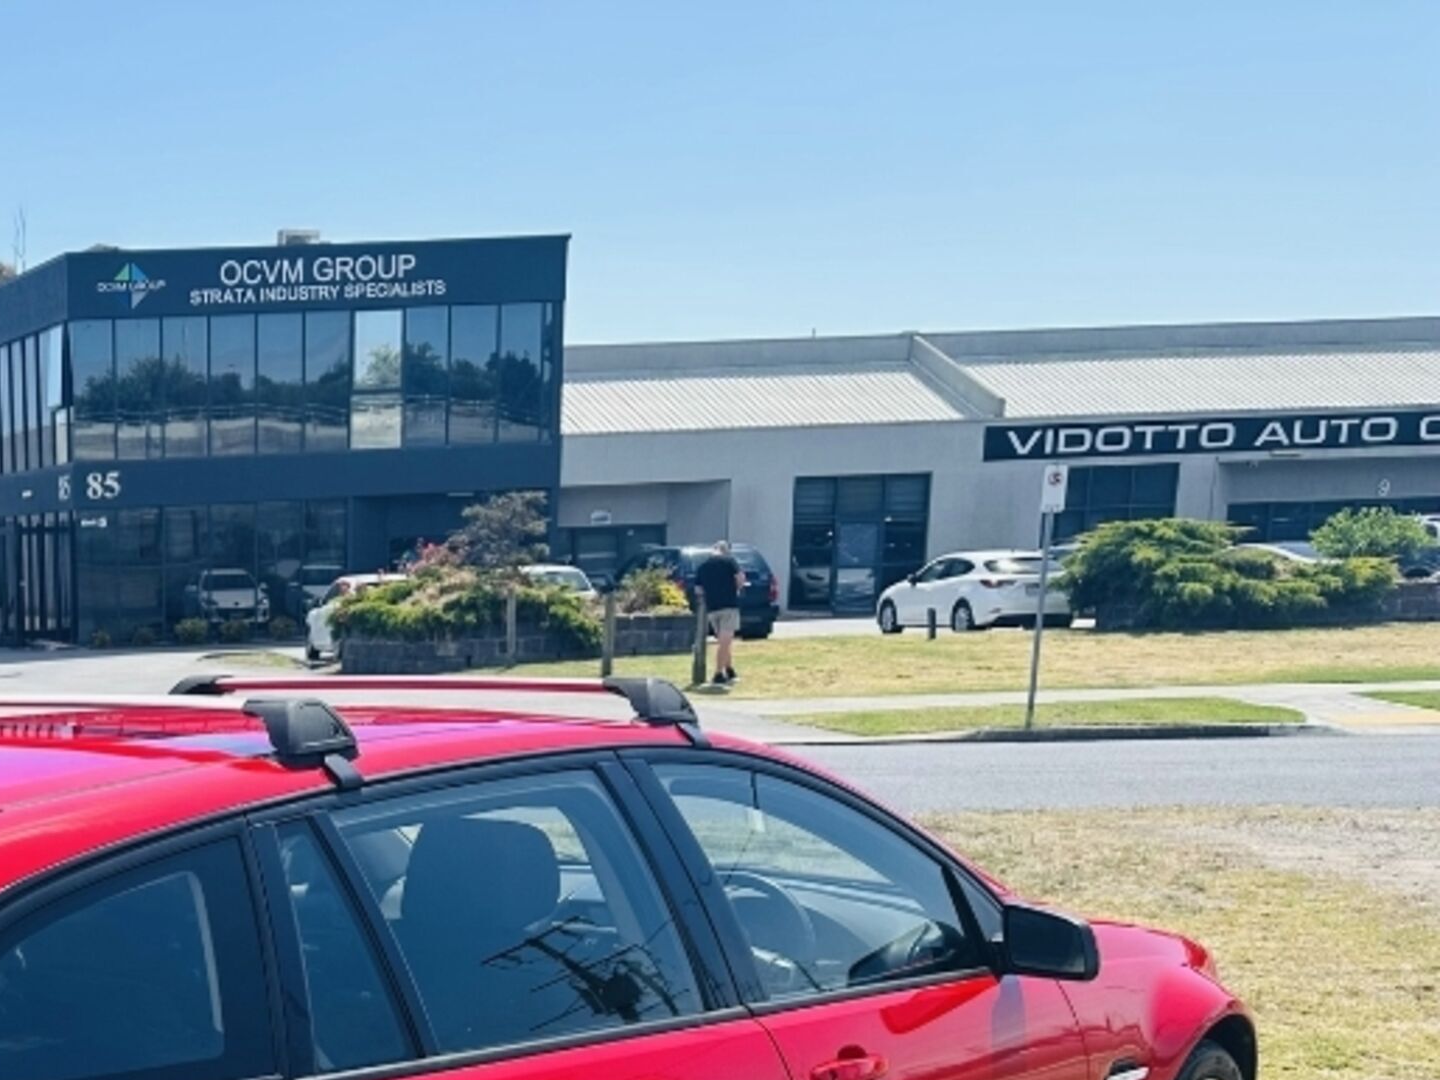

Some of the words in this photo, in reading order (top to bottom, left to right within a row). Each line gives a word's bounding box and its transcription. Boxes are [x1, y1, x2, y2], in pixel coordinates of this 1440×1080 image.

[220, 258, 304, 285] OCVM
[312, 254, 416, 281] GROUP
[190, 287, 257, 306] STRATA
[260, 284, 341, 302] INDUSTRY
[343, 280, 446, 299] SPECIALISTS
[1007, 422, 1235, 456] VIDOTTO
[1255, 416, 1398, 447] AUTO
[87, 471, 121, 499] 85
